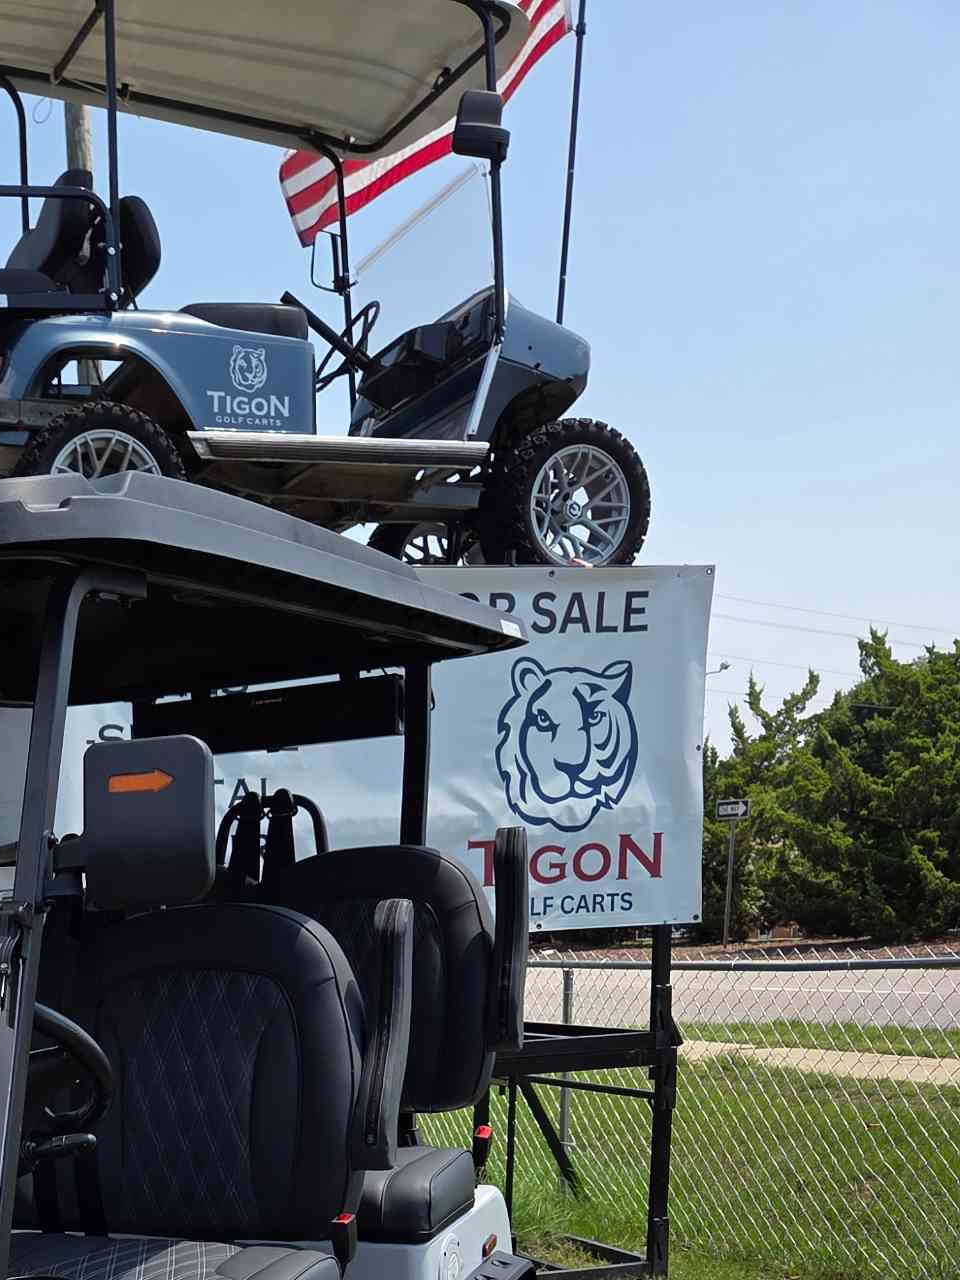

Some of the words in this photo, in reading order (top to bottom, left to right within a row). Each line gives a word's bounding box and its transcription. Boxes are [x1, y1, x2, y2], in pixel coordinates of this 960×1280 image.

[206, 391, 290, 417] TIGON
[215, 415, 244, 424] GOLF
[246, 417, 281, 426] CARTS
[531, 591, 649, 634] SALE
[467, 832, 665, 887] TGON
[560, 892, 633, 914] CARTS
